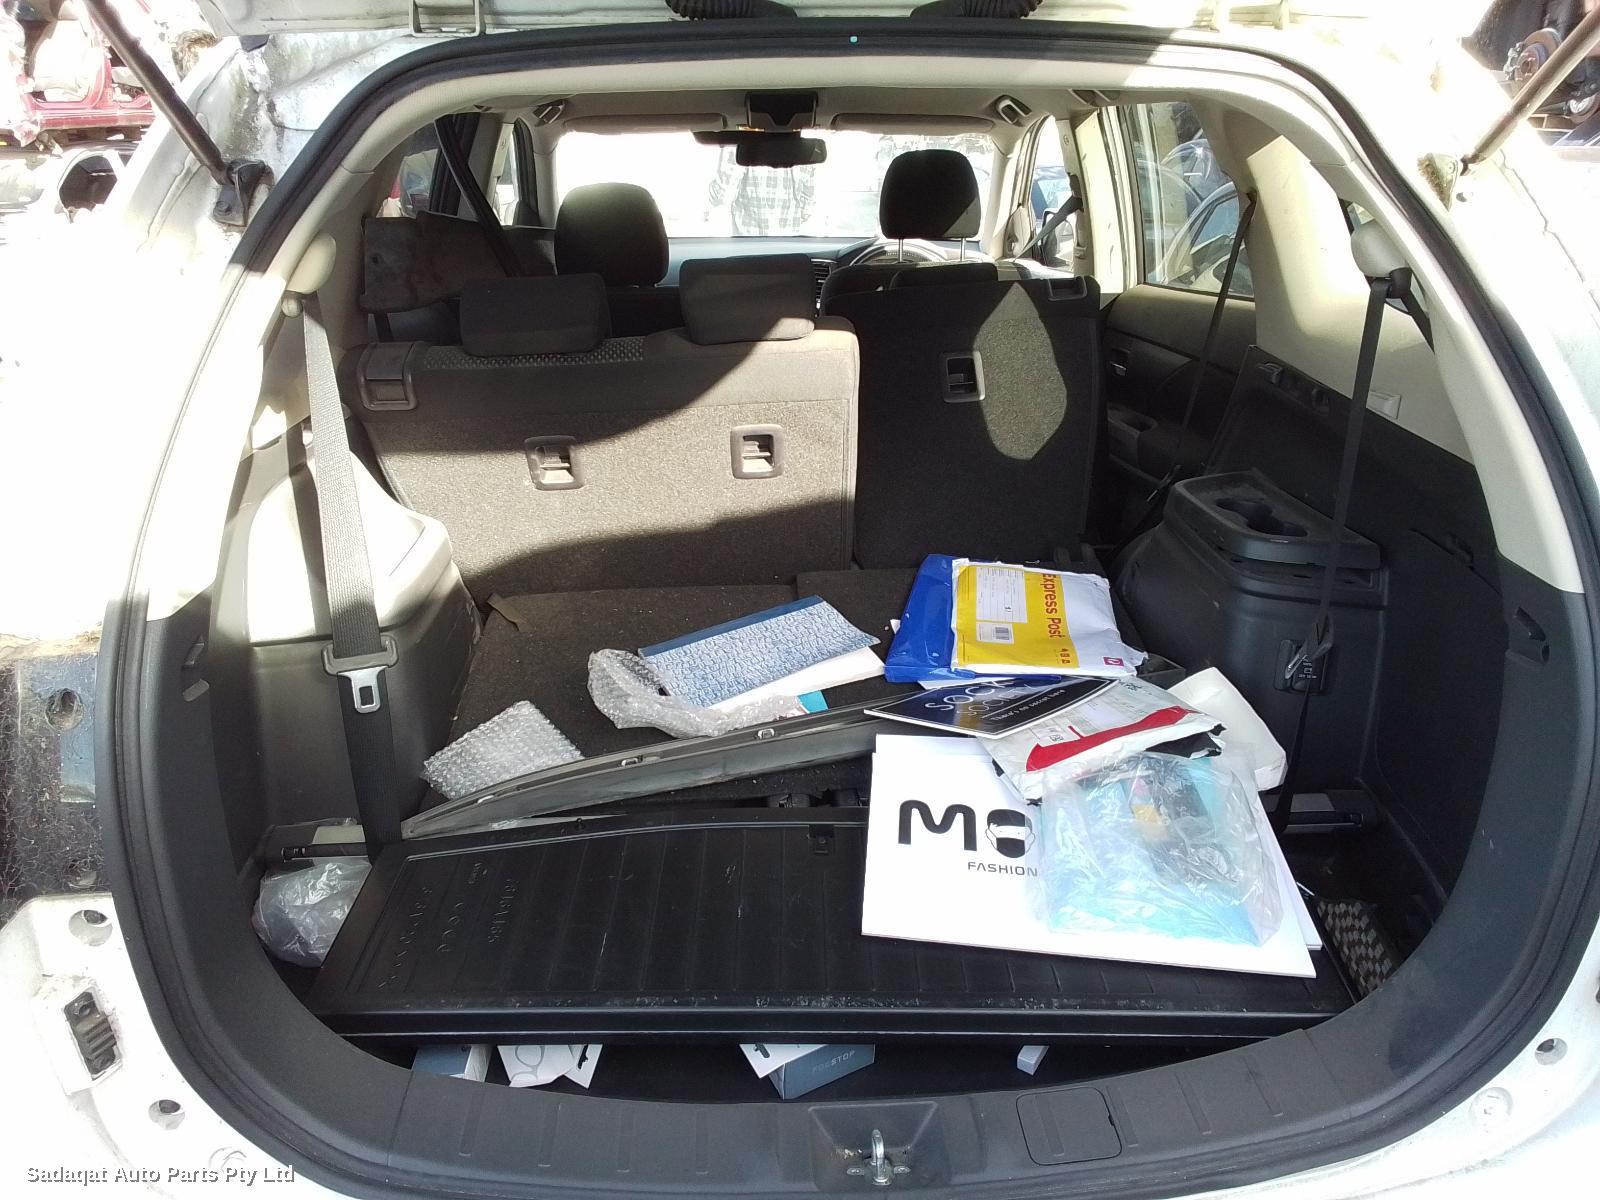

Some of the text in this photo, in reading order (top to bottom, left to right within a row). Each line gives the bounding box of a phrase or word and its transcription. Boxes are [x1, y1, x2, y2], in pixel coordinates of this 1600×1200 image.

[1040, 573, 1066, 638] Express Post
[967, 861, 1038, 877] FASHION
